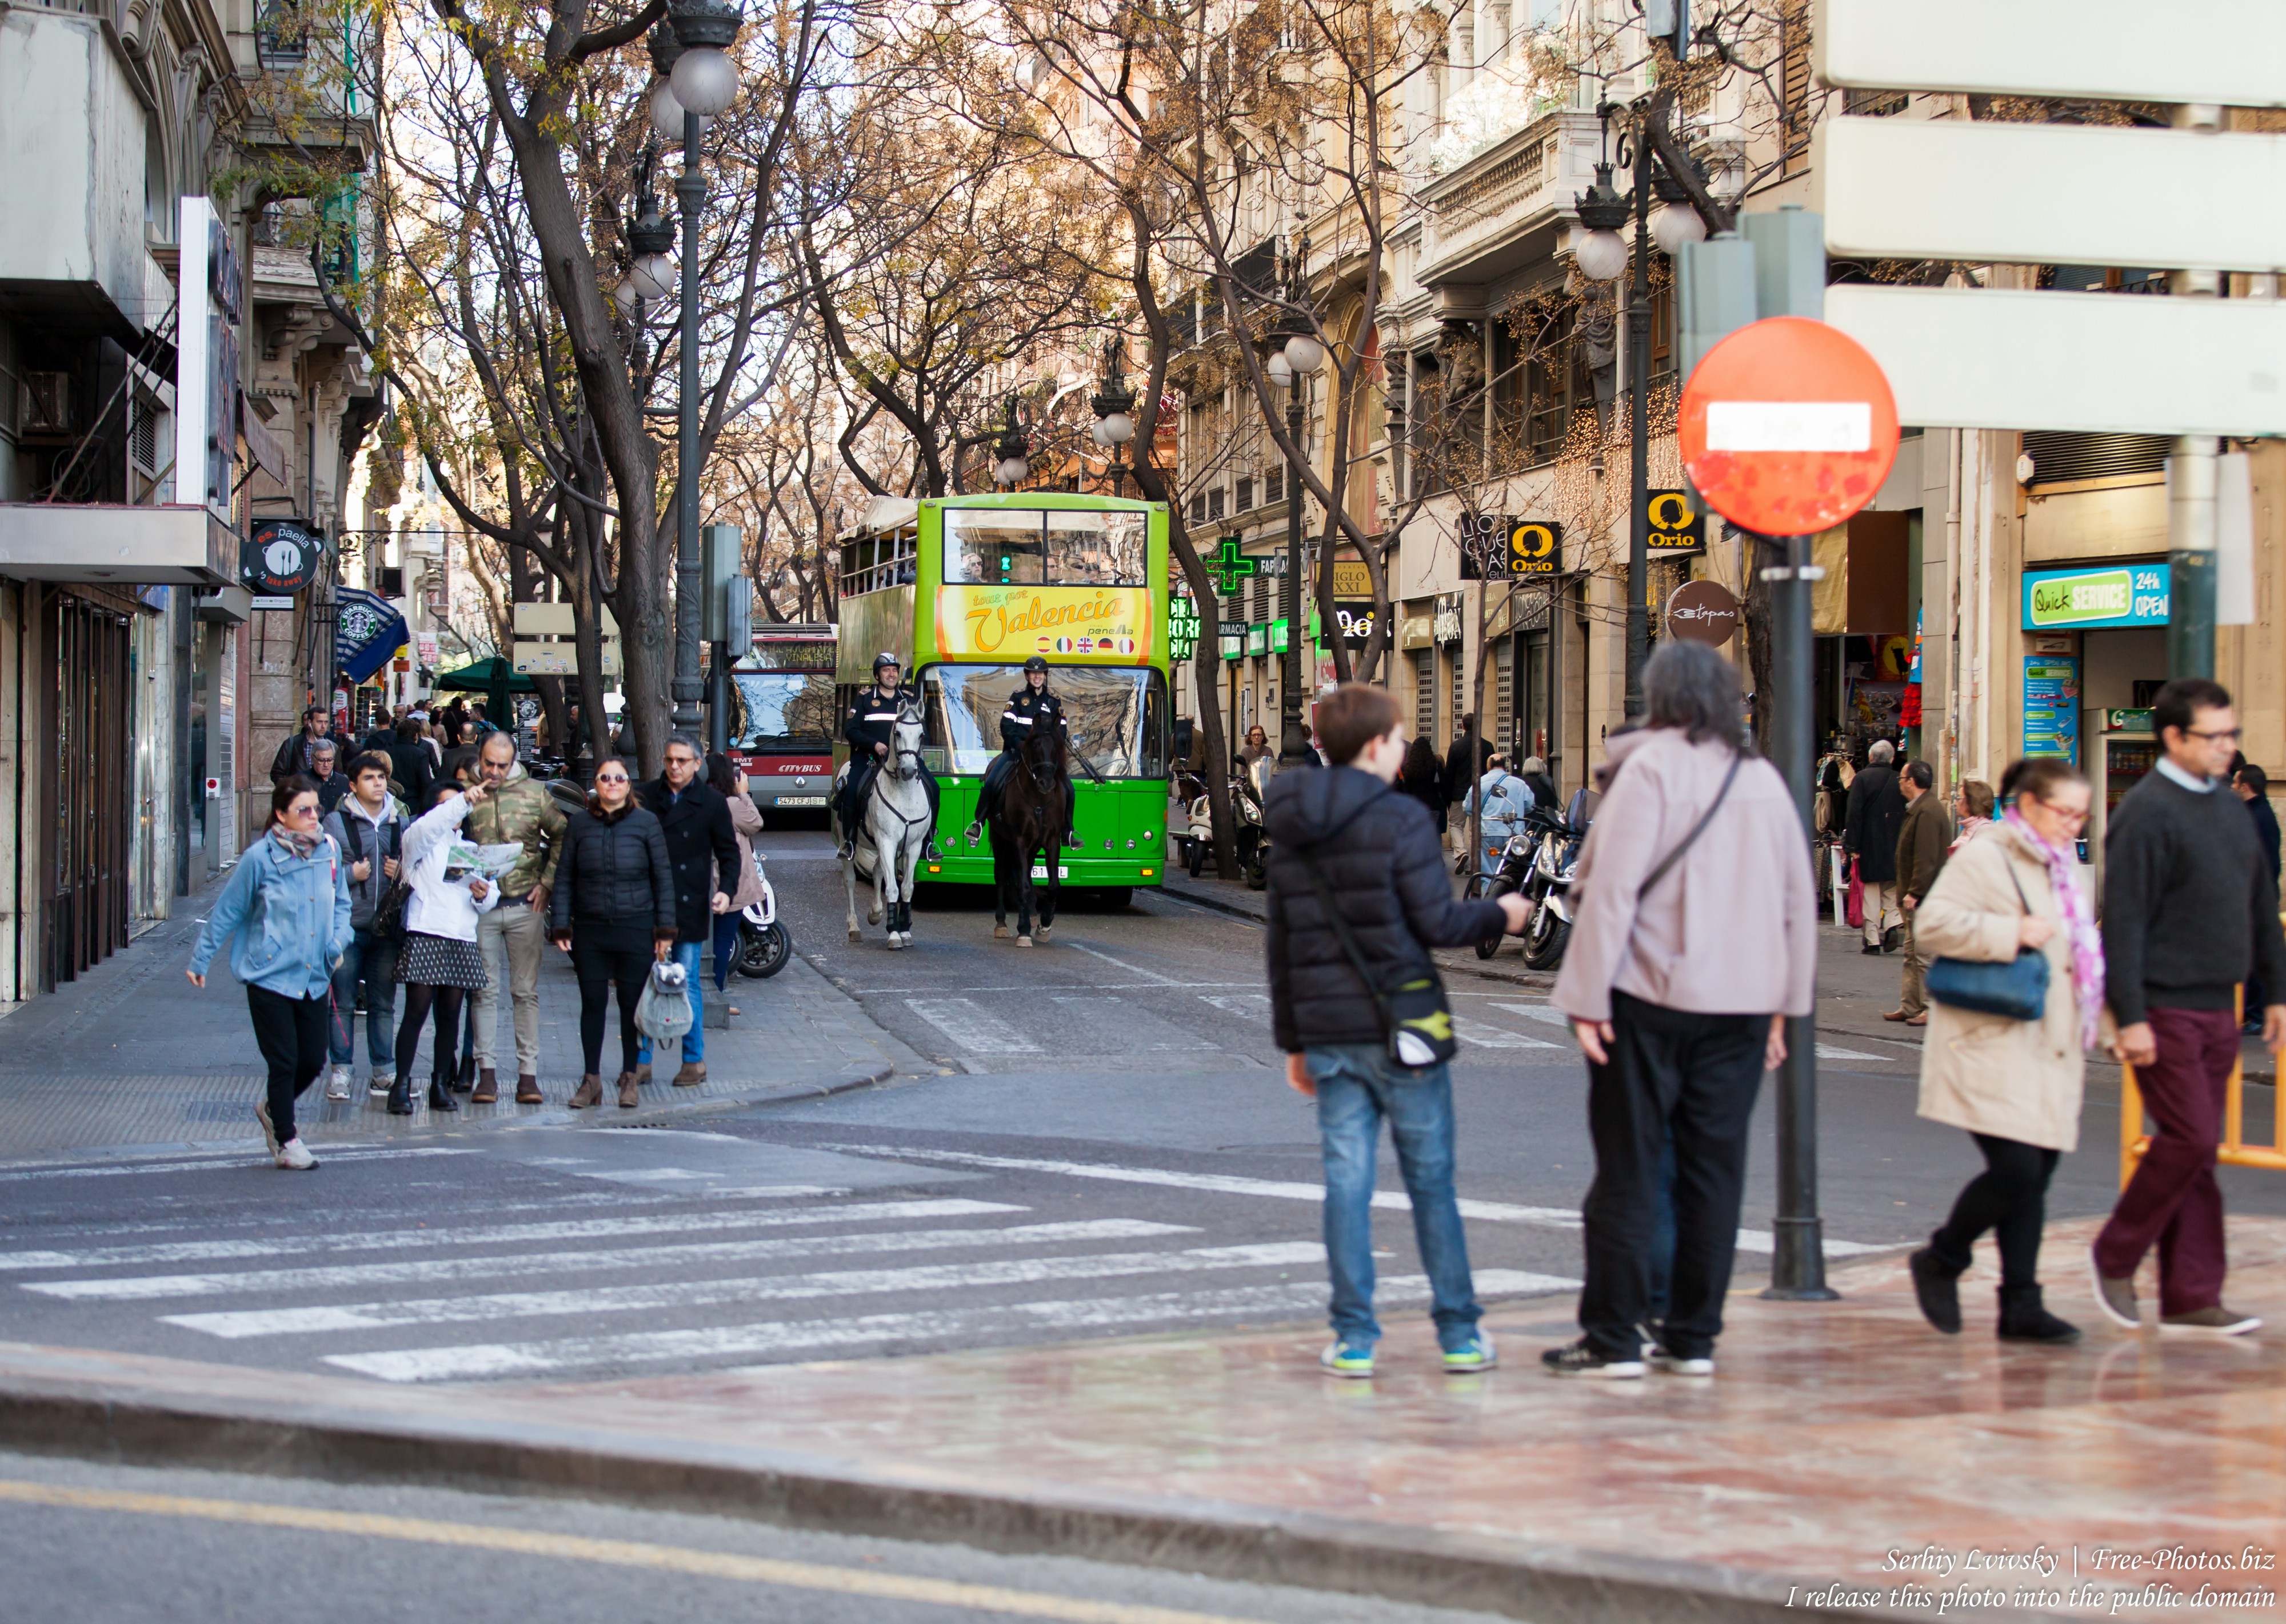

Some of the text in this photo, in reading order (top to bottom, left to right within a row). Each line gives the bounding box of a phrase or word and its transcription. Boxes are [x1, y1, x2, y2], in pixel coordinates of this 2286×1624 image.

[258, 528, 309, 549] es. paella
[1648, 533, 1694, 546] Orio
[1512, 559, 1553, 571] Orio
[266, 575, 302, 587] take away
[1333, 571, 1365, 582] IGLO
[2135, 572, 2160, 590] 24h
[1334, 582, 1360, 593] XXI
[973, 589, 1028, 606] tour por
[2035, 583, 2127, 613] Quick SERVICE
[2135, 594, 2169, 617] OPEN
[343, 606, 375, 623] STARBUCKS
[964, 591, 1125, 653] Valencia
[345, 628, 370, 639] COFFEE
